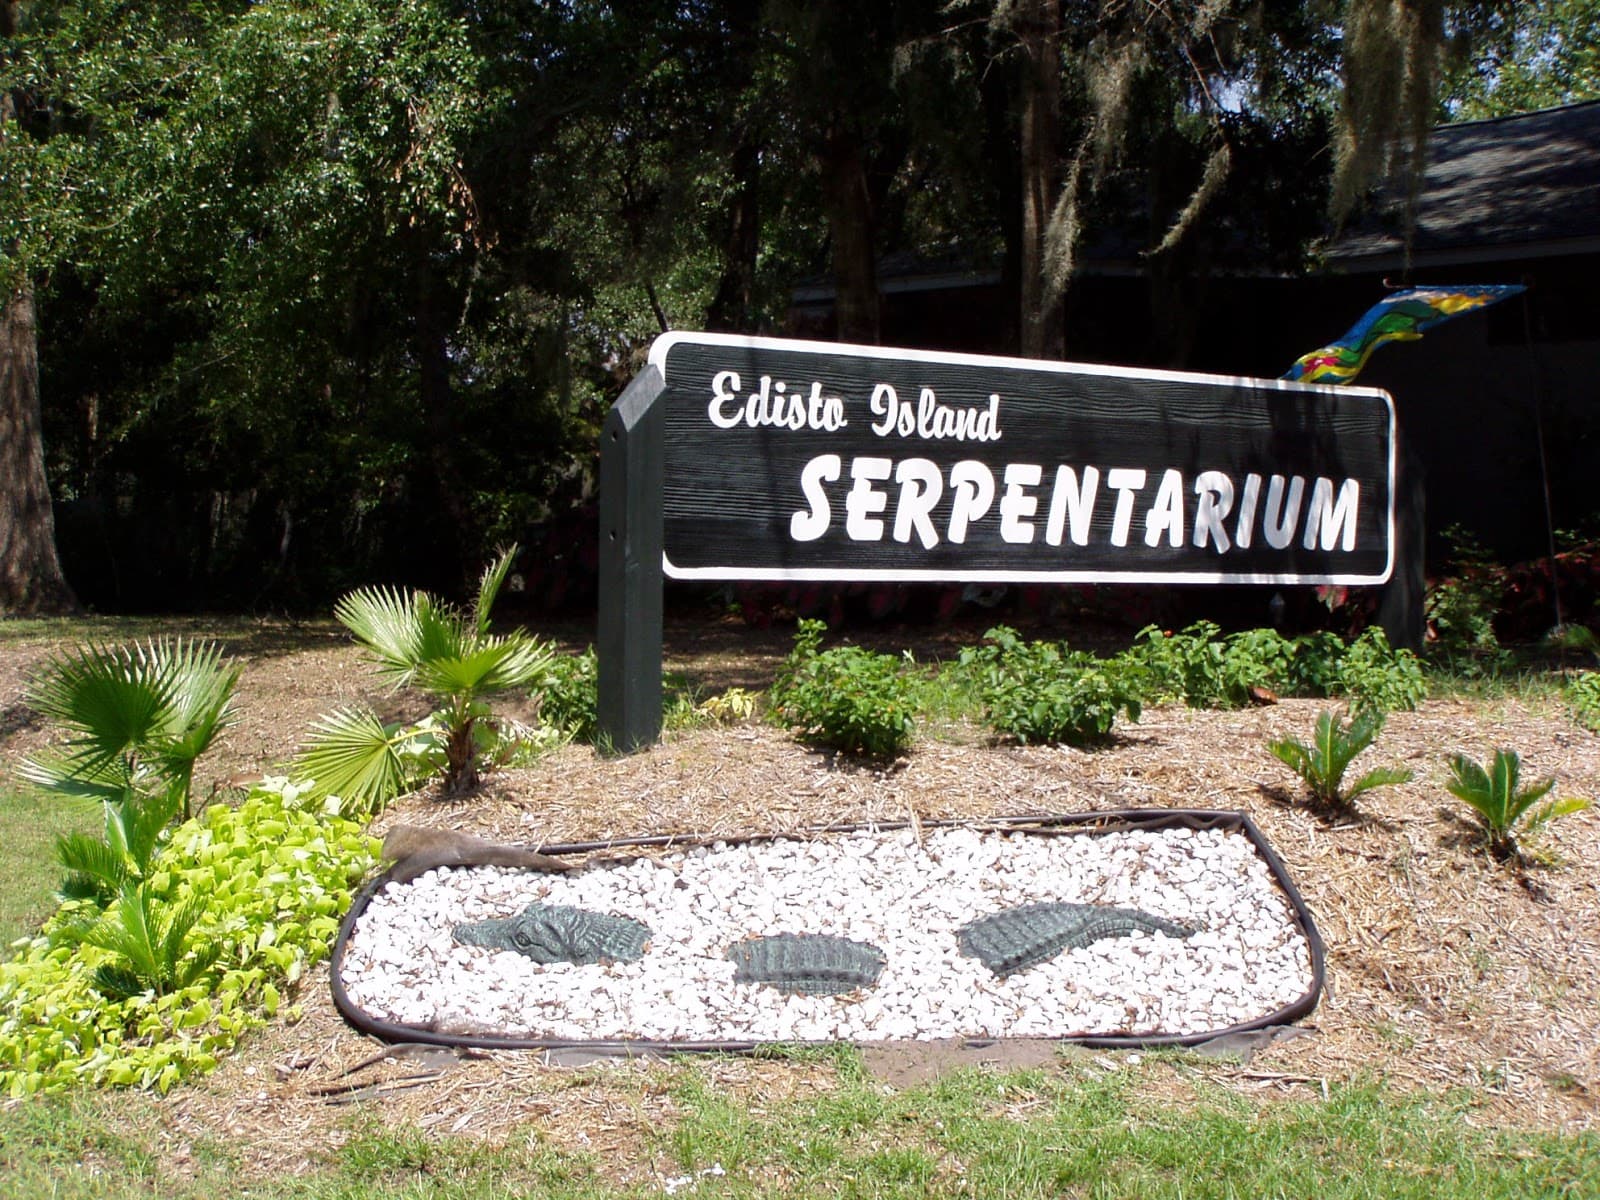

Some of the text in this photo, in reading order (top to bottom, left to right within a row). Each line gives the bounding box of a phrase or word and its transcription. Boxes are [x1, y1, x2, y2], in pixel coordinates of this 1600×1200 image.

[707, 370, 1003, 443] Edisto Island
[790, 454, 1360, 554] SERPENTARIUM
